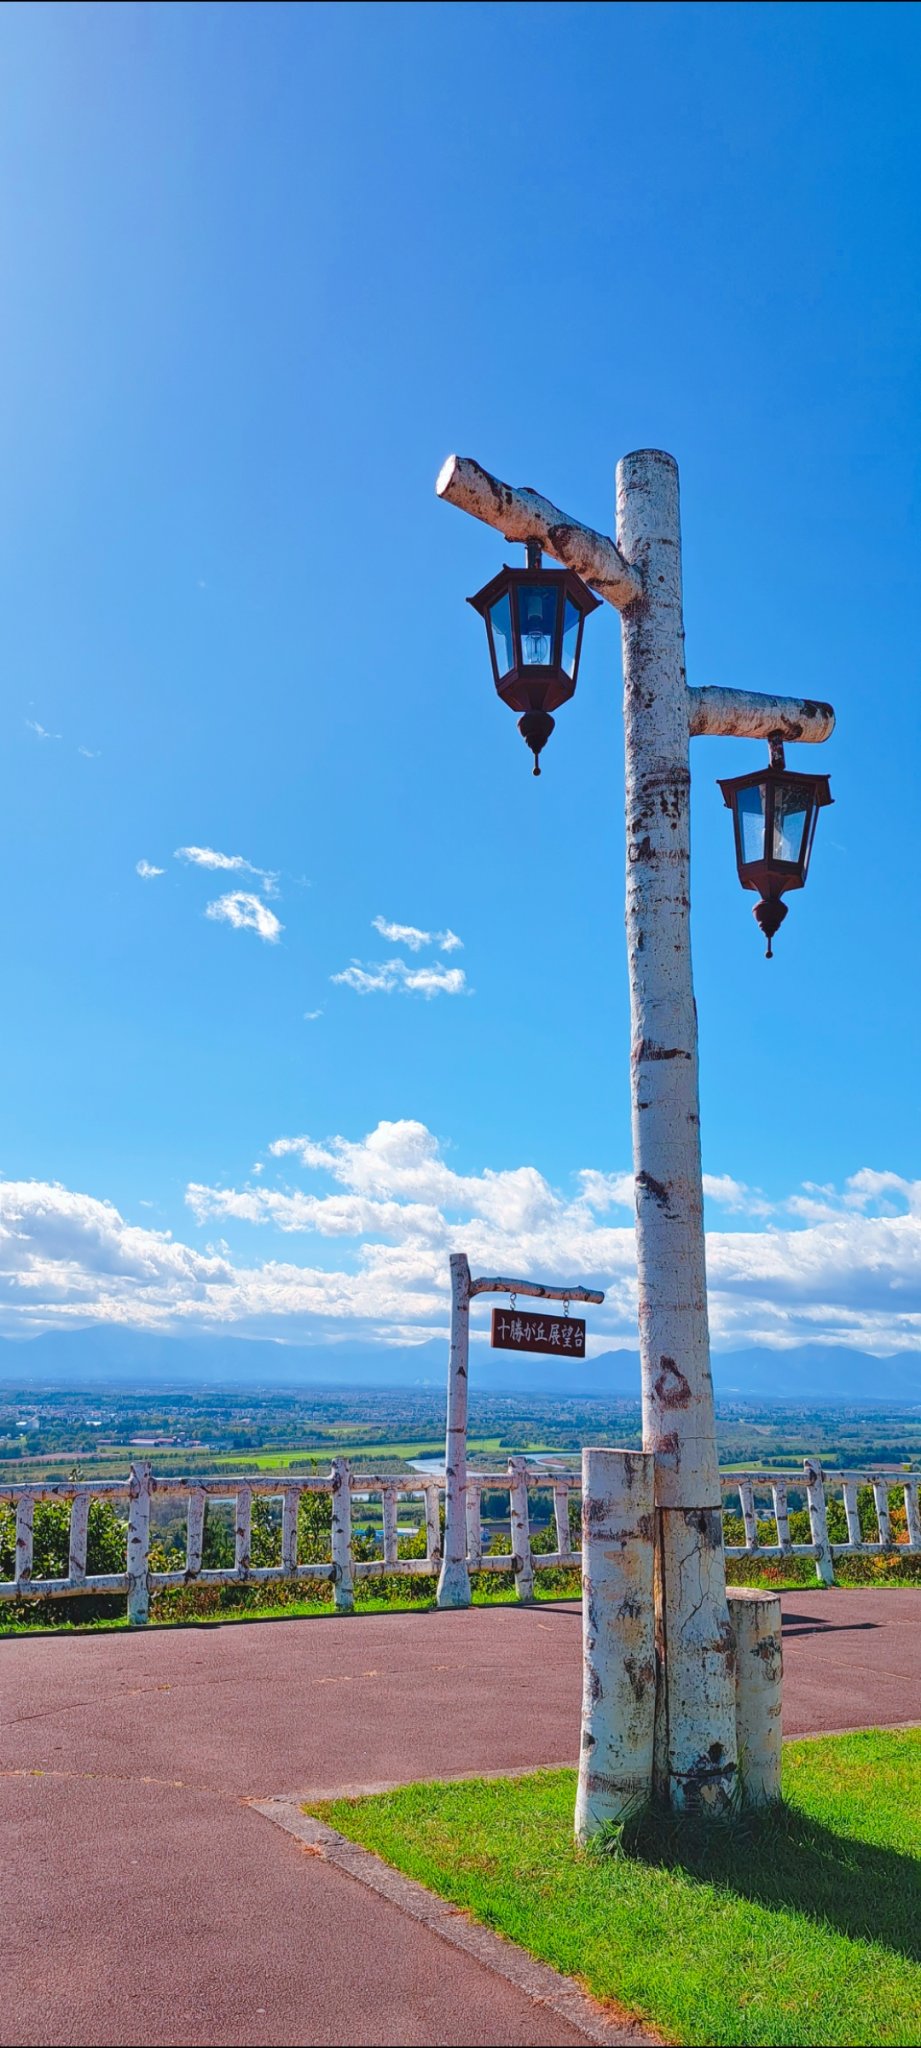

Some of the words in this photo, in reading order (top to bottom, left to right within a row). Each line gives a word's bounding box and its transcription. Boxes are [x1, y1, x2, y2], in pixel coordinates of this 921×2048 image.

[497, 1317, 584, 1348] 十勝が丘展望台
